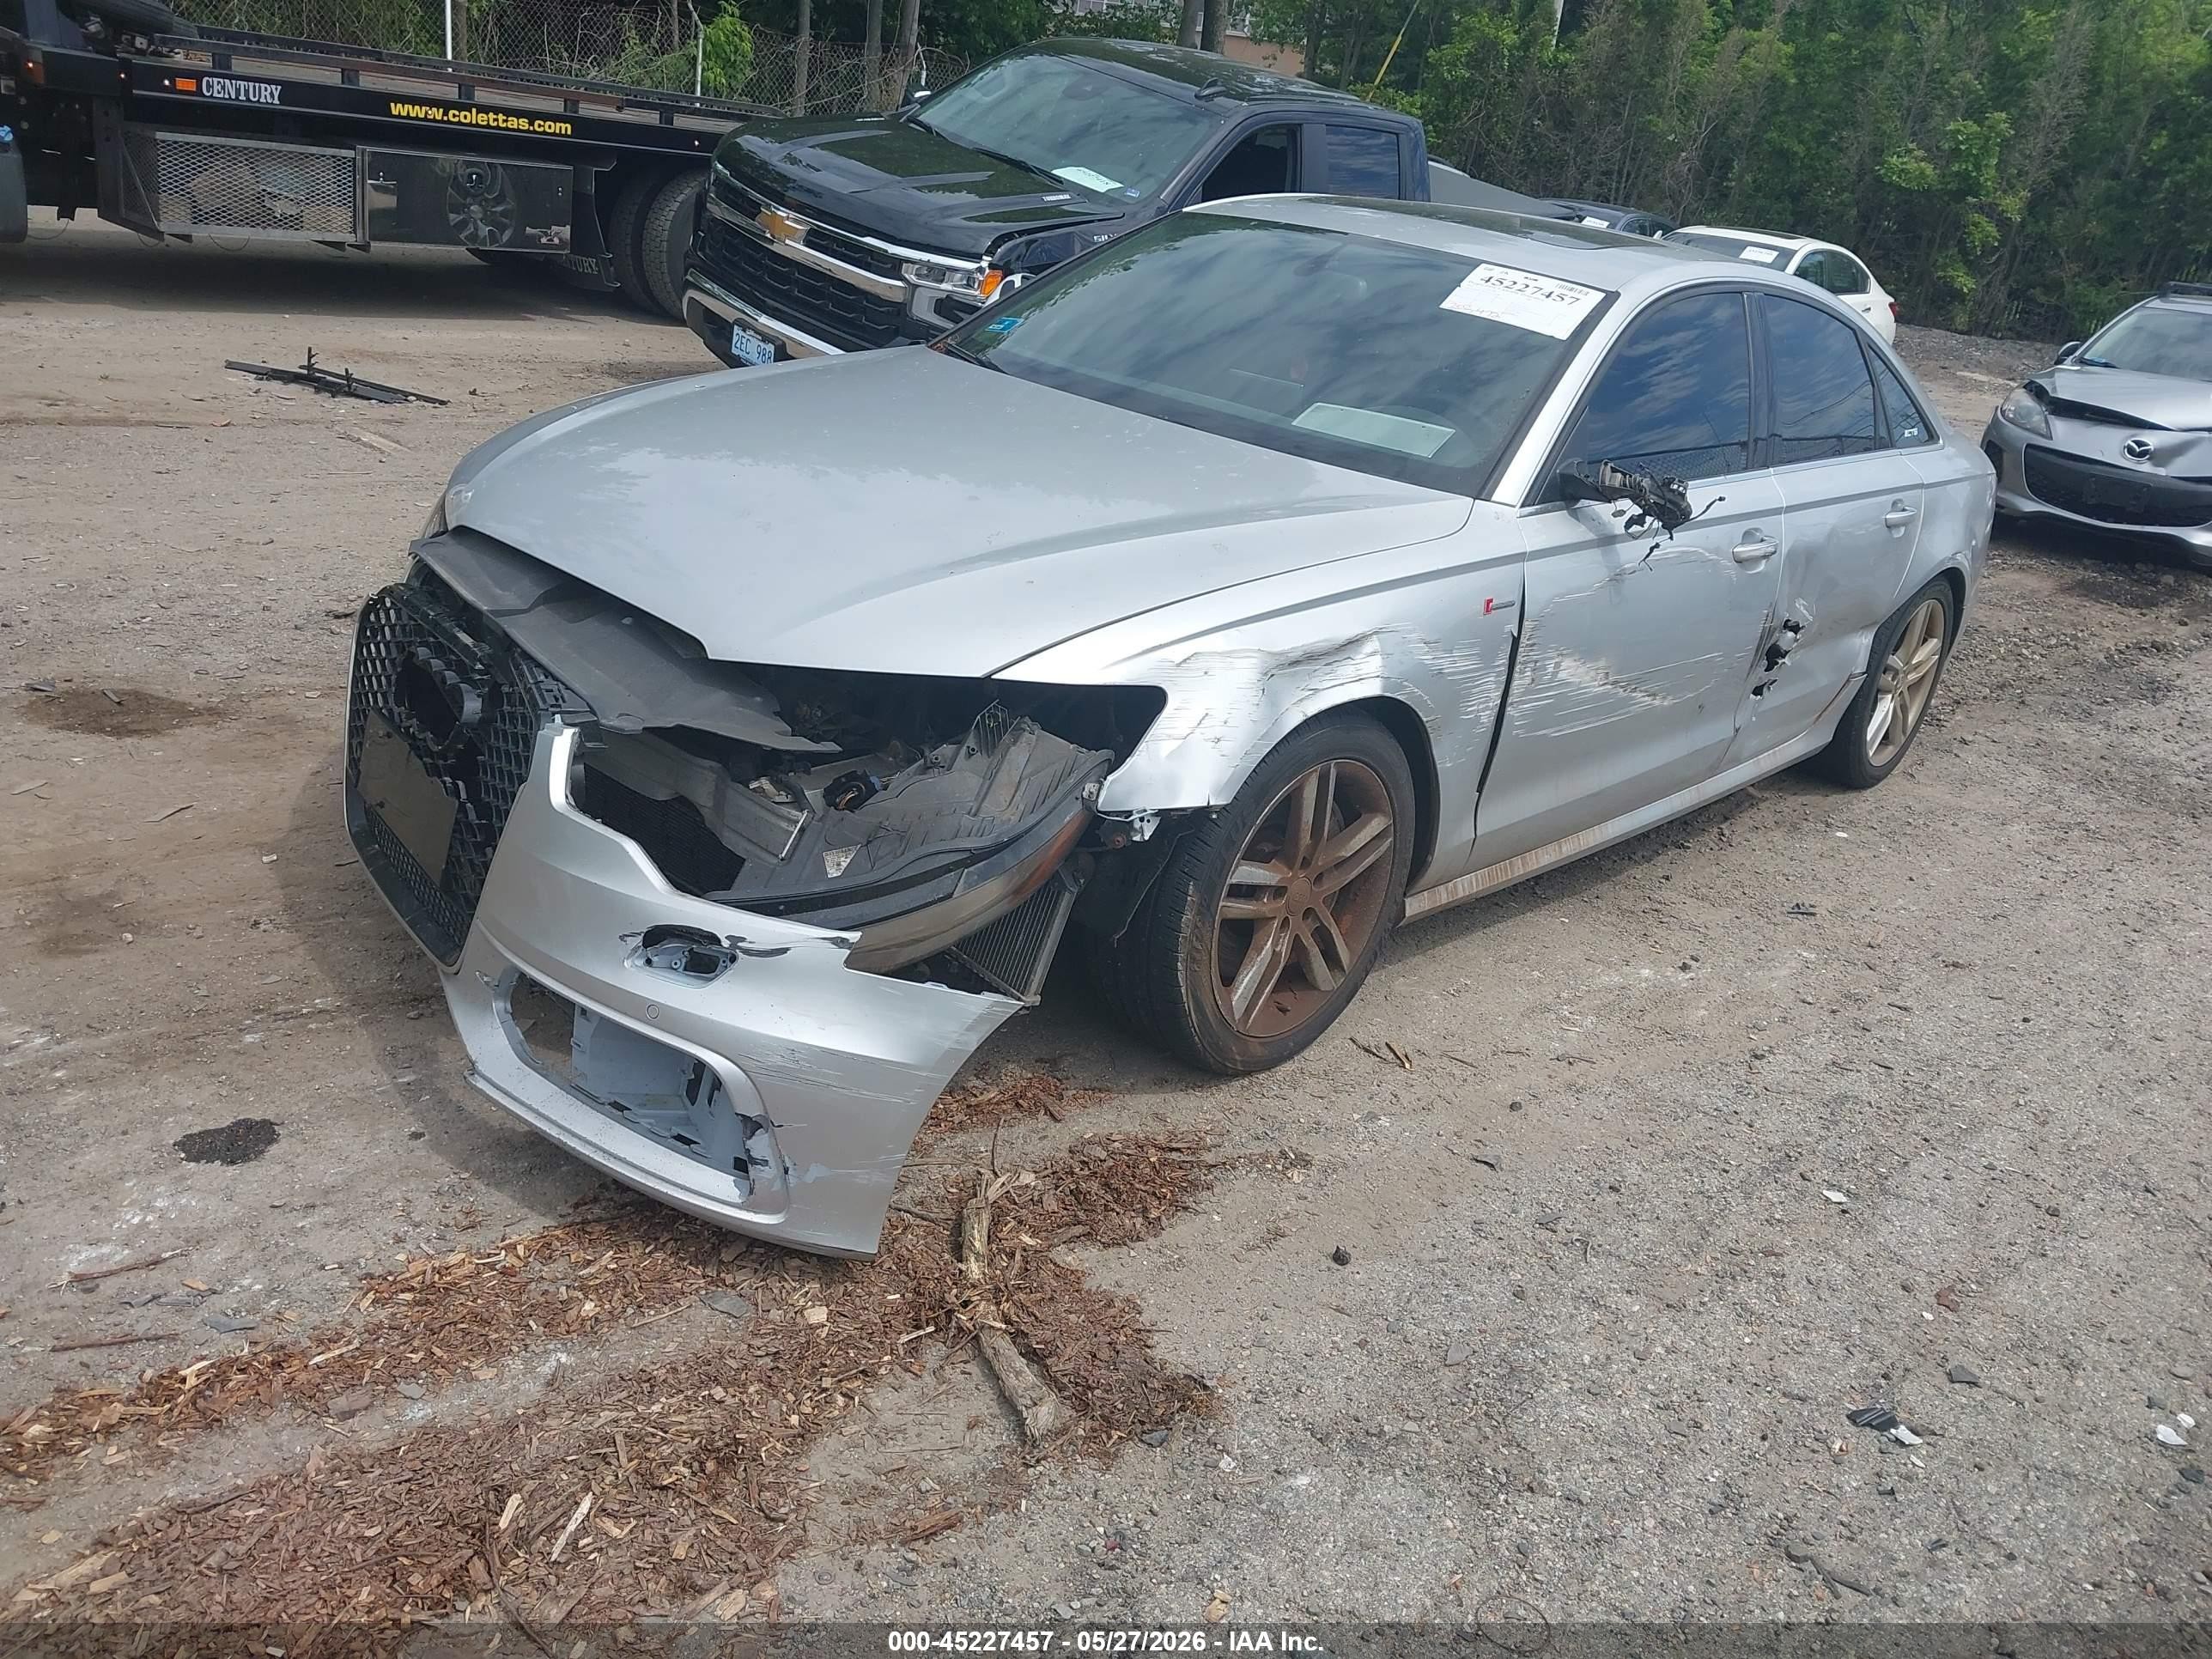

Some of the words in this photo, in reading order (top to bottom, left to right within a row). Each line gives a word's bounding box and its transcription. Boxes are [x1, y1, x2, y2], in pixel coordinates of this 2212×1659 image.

[202, 76, 282, 105] CENTURY
[390, 102, 572, 135] www.colettas.com
[1480, 276, 1581, 306] 45227457
[734, 332, 751, 356] 2EC
